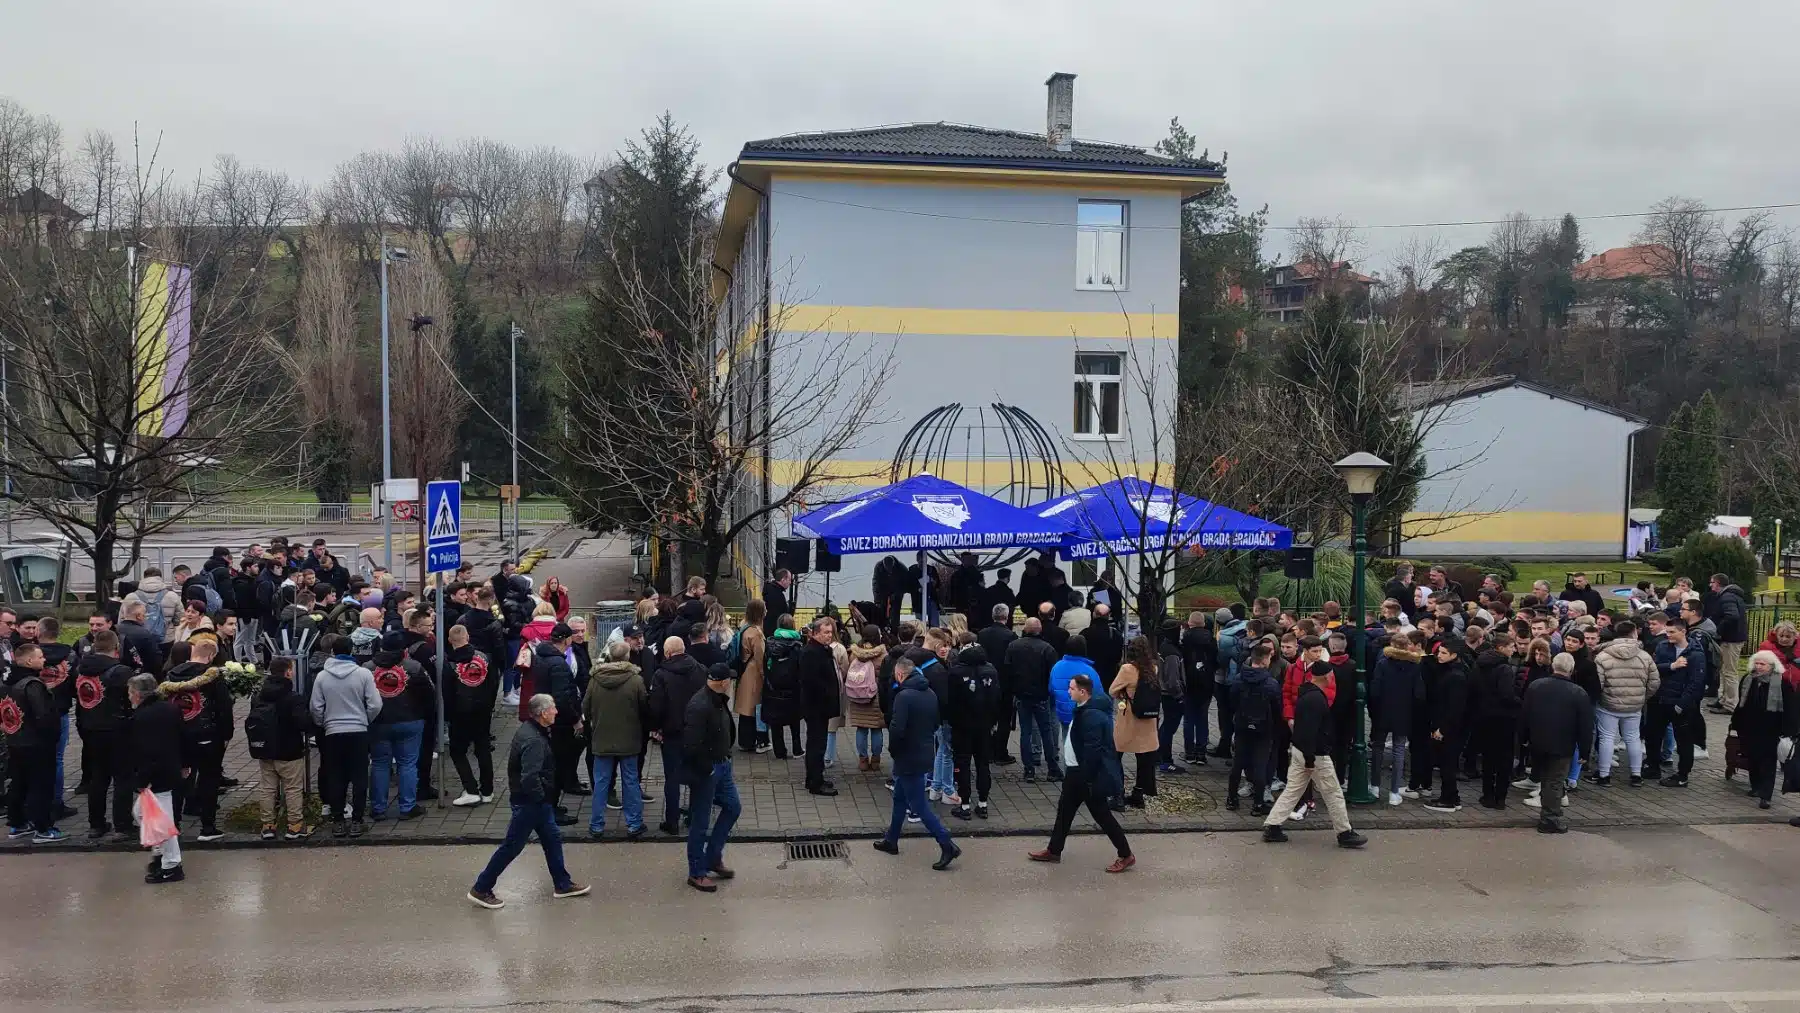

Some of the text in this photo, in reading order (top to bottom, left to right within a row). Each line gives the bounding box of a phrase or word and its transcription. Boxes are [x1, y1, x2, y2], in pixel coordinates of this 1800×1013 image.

[840, 537, 871, 551] SAVEZ
[872, 533, 918, 550] BORAČKIH
[920, 533, 982, 548] ORGANIZACIJA
[984, 532, 1014, 545] GRADA
[1070, 542, 1098, 557] SAVEZ
[1202, 532, 1230, 546] GRADA
[440, 552, 459, 565] Policija
